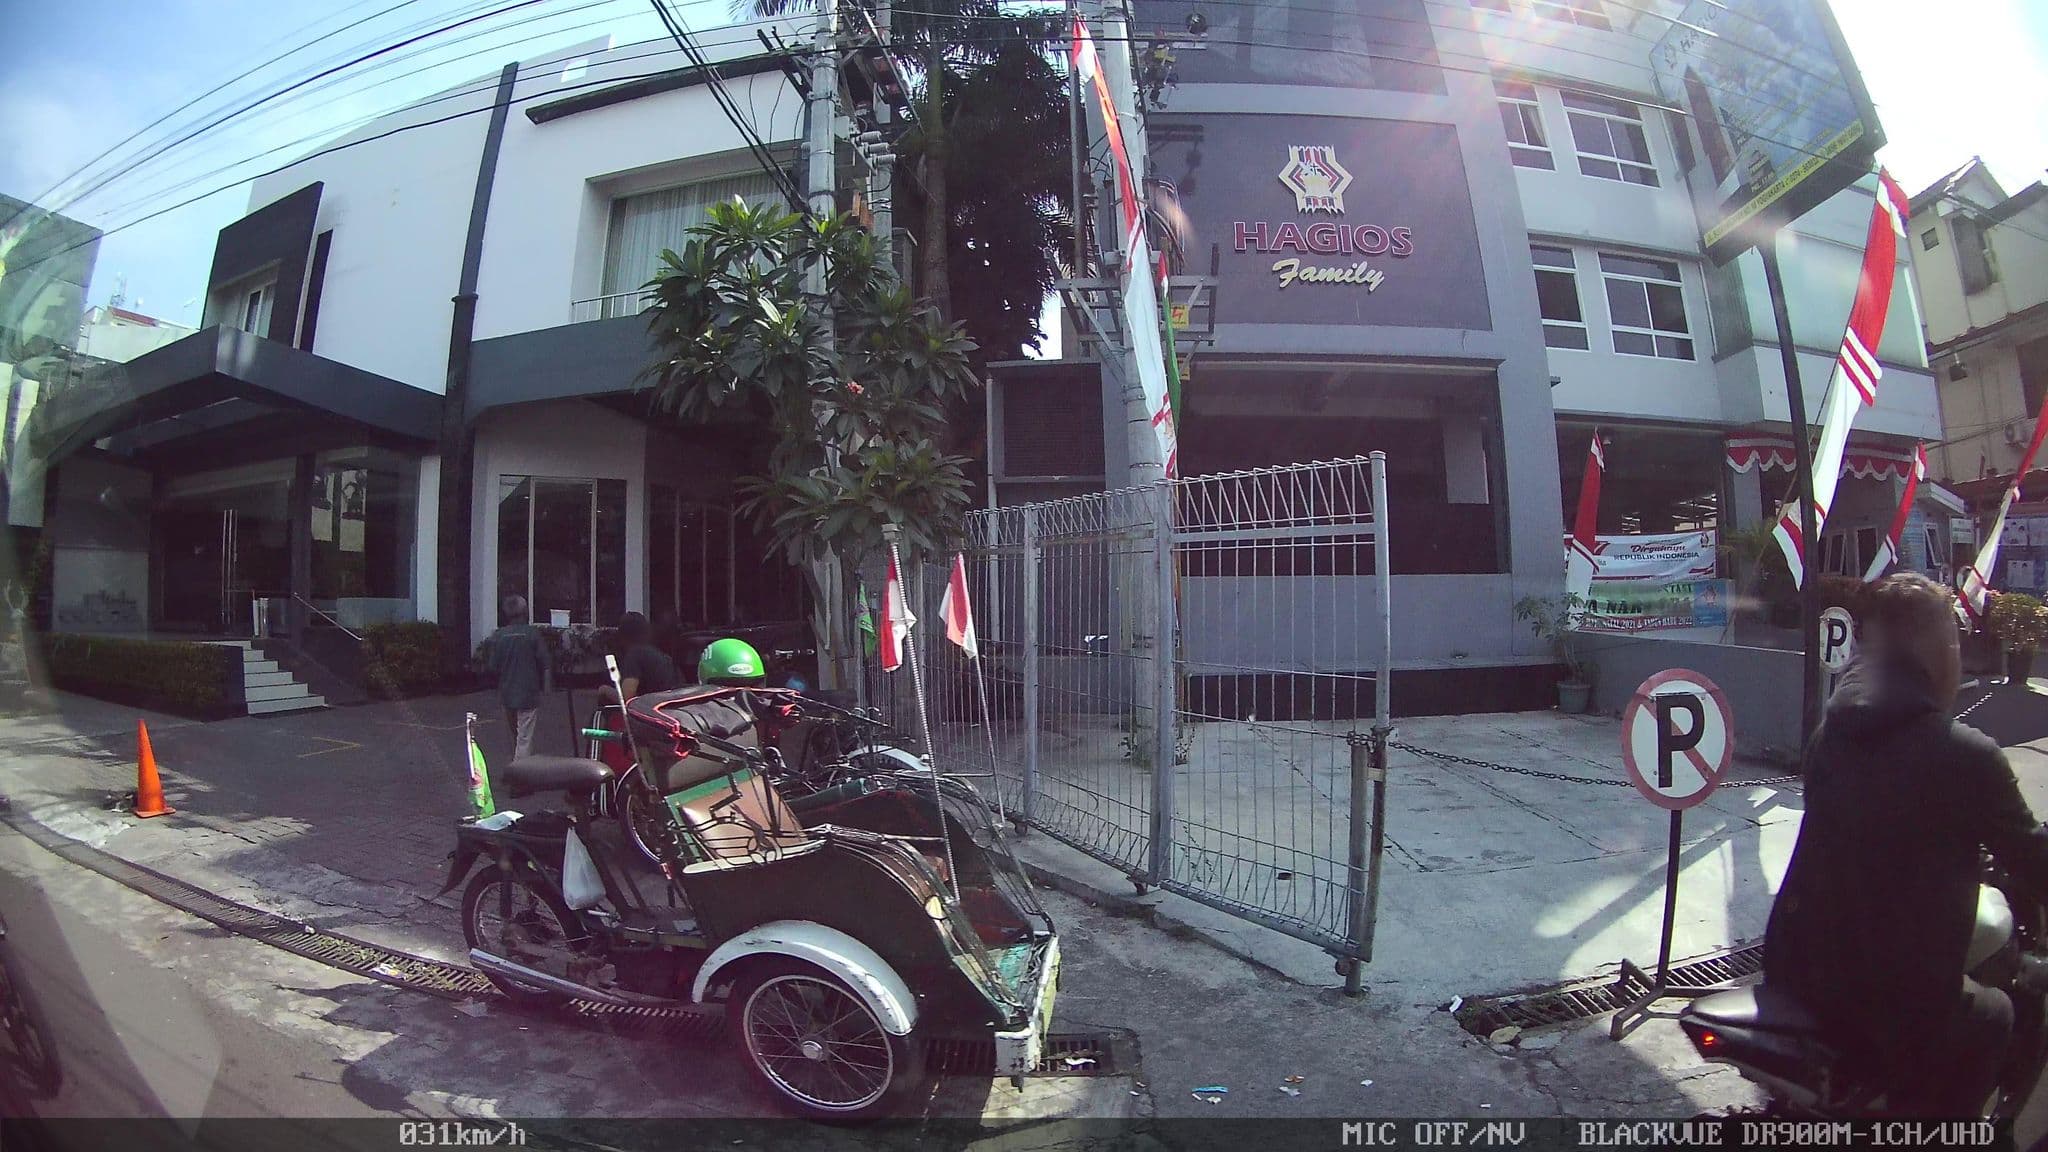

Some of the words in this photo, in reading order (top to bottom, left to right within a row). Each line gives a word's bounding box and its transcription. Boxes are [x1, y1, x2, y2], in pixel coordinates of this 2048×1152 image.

[1234, 221, 1414, 256] HAGIOS
[1272, 258, 1385, 292] Family
[1613, 553, 1656, 561] REPUBLIK
[1656, 552, 1700, 560] INDONESIA
[1630, 544, 1687, 554] Dirgahayu
[1656, 692, 1705, 788] P
